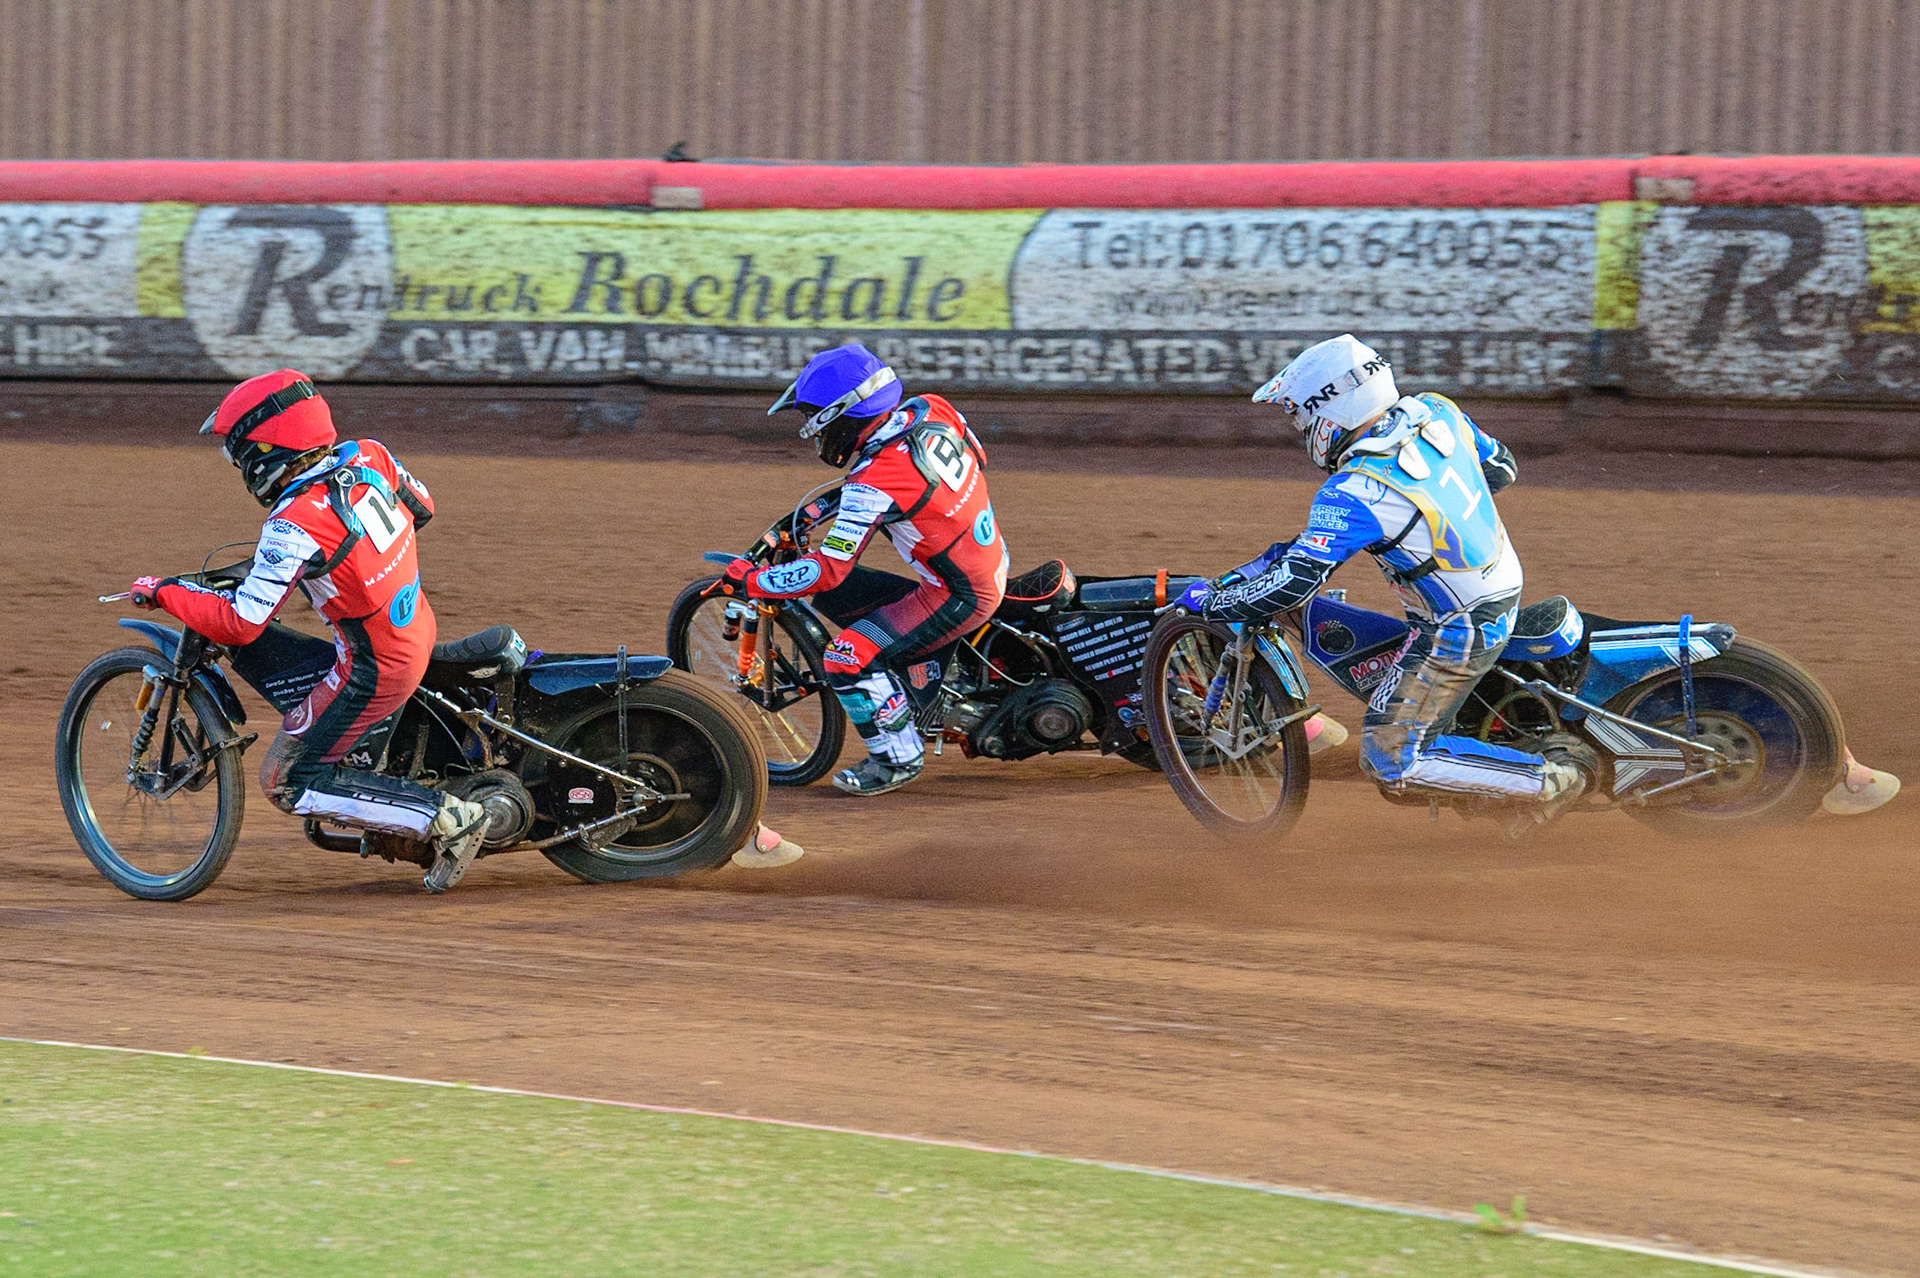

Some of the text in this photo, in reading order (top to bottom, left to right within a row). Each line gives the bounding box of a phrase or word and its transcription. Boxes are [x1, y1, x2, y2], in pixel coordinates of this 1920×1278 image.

[560, 250, 966, 325] Rochdale
[14, 324, 125, 368] HIRE
[1459, 339, 1580, 386] HIRE
[934, 434, 966, 480] 5
[368, 495, 396, 536] 1
[1438, 466, 1483, 522] 1
[836, 525, 863, 537] MAGURA
[766, 566, 810, 589] FRP
